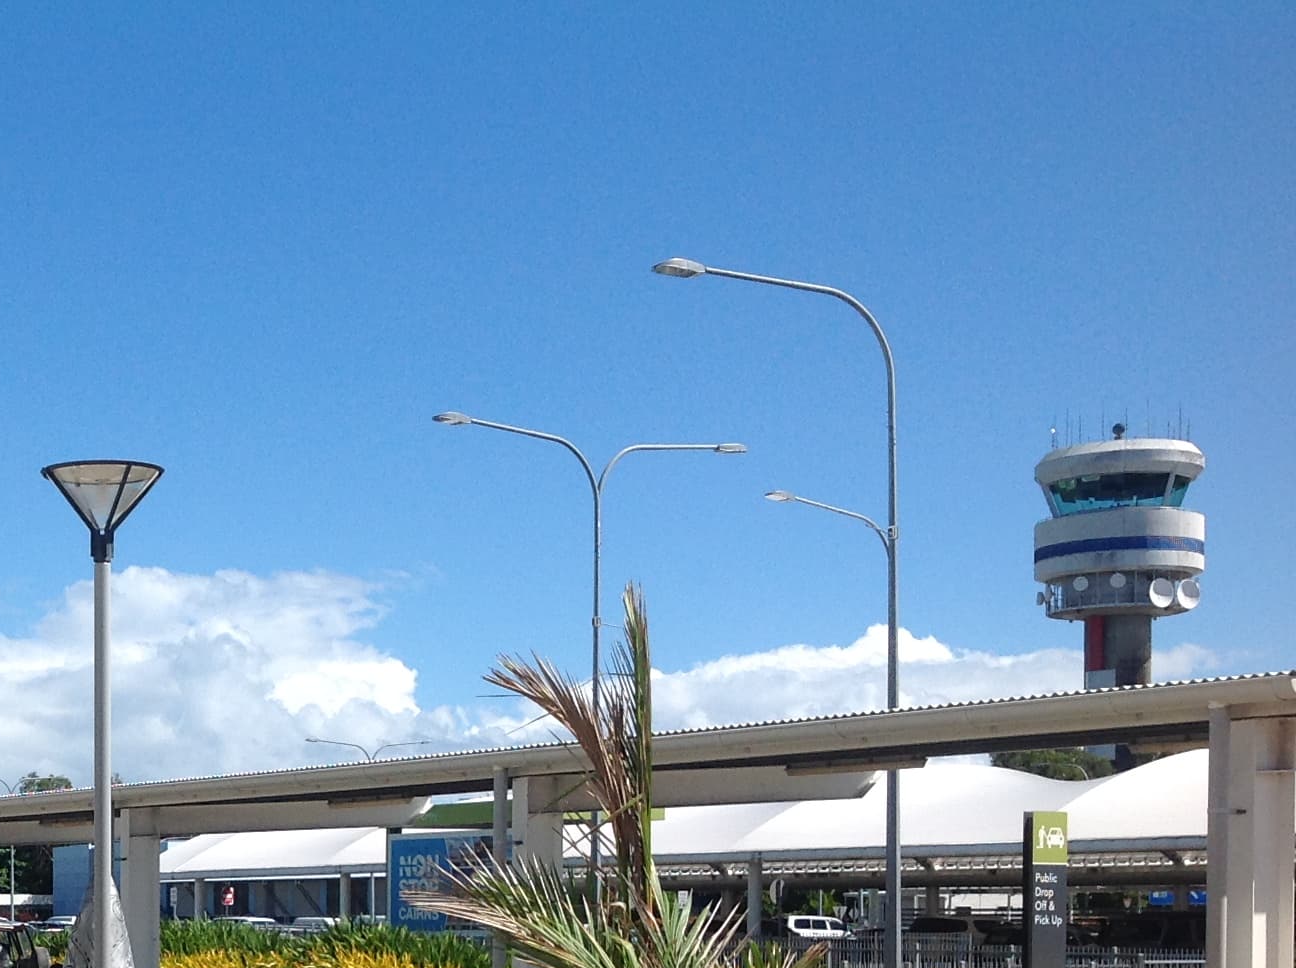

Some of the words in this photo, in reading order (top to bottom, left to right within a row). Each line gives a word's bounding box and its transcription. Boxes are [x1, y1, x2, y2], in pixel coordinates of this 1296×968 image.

[399, 854, 440, 877] NON
[1035, 872, 1058, 883] Public
[1035, 886, 1054, 900] Drop
[1034, 900, 1047, 911] Off
[1048, 900, 1055, 911] &
[399, 906, 440, 920] CAIRNS
[1034, 914, 1050, 925] Pick
[1051, 914, 1063, 928] Up
